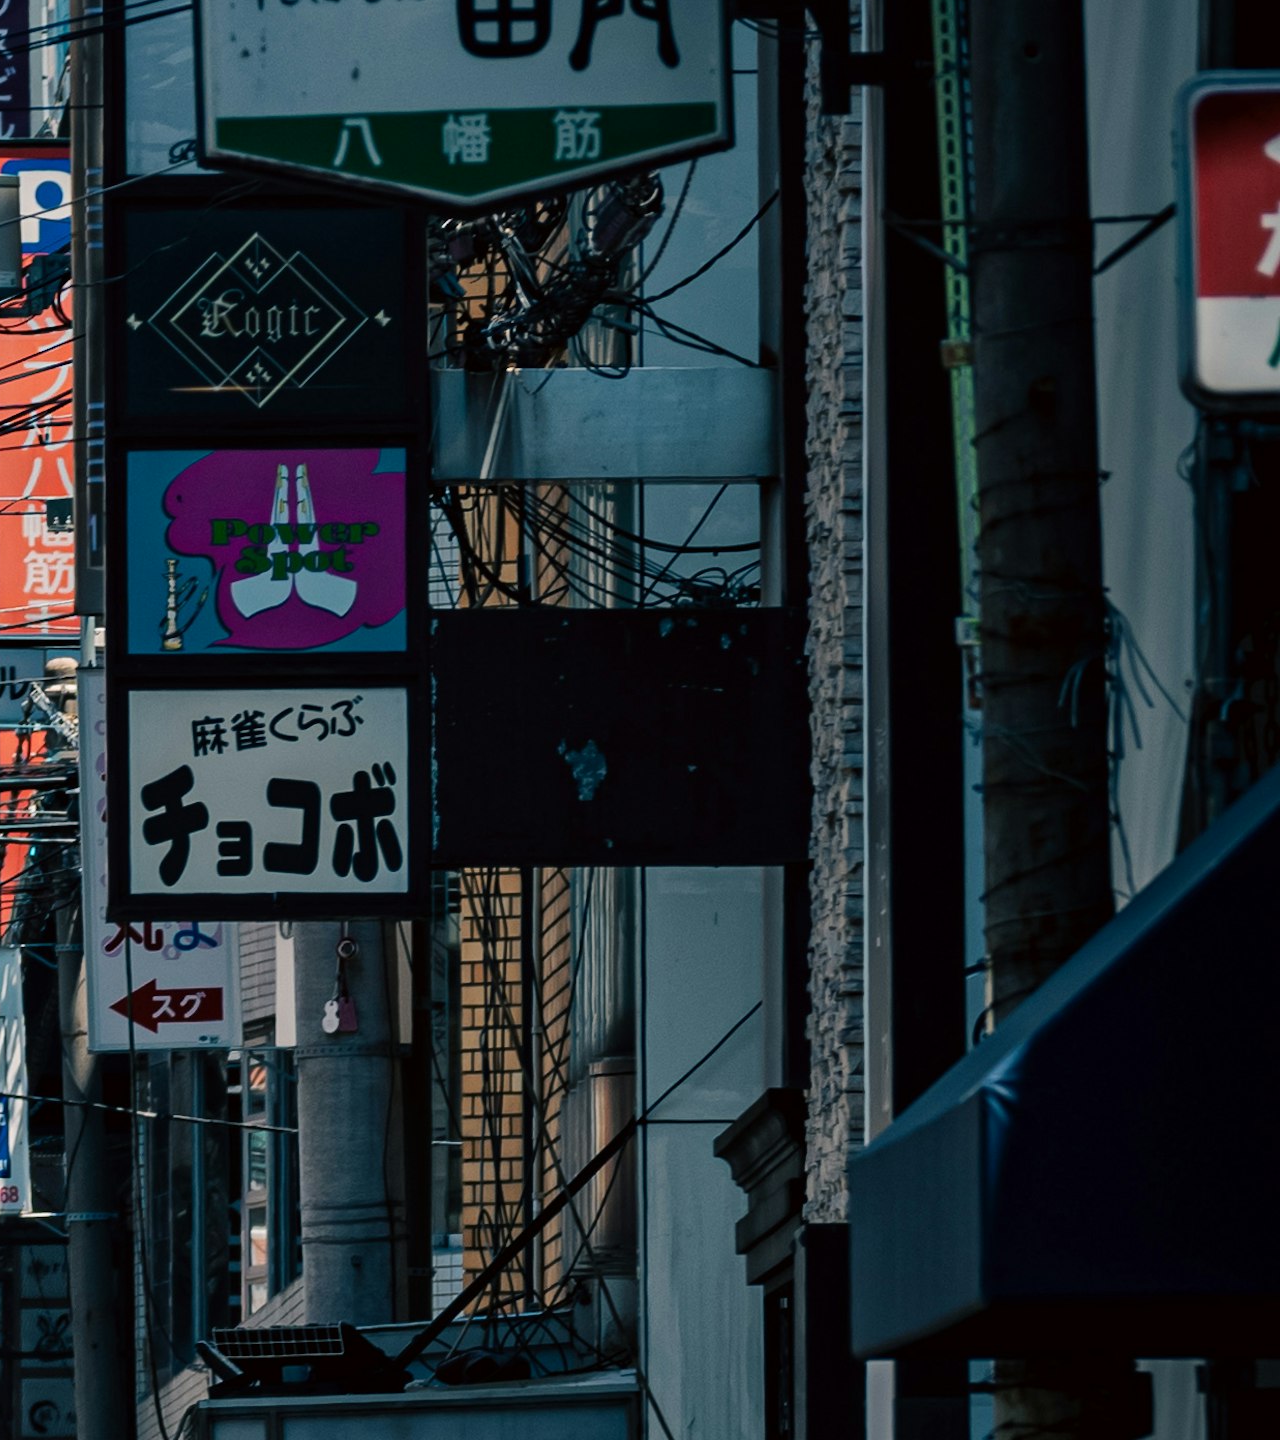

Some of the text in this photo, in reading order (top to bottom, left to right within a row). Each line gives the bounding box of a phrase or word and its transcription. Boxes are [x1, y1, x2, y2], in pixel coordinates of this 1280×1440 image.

[332, 109, 602, 168] 八幡筋
[210, 517, 381, 547] Power
[234, 541, 354, 581] Spot
[191, 698, 365, 757] 麻雀くらぶ
[140, 763, 404, 887] チョコボ
[151, 990, 207, 1021] スグ
